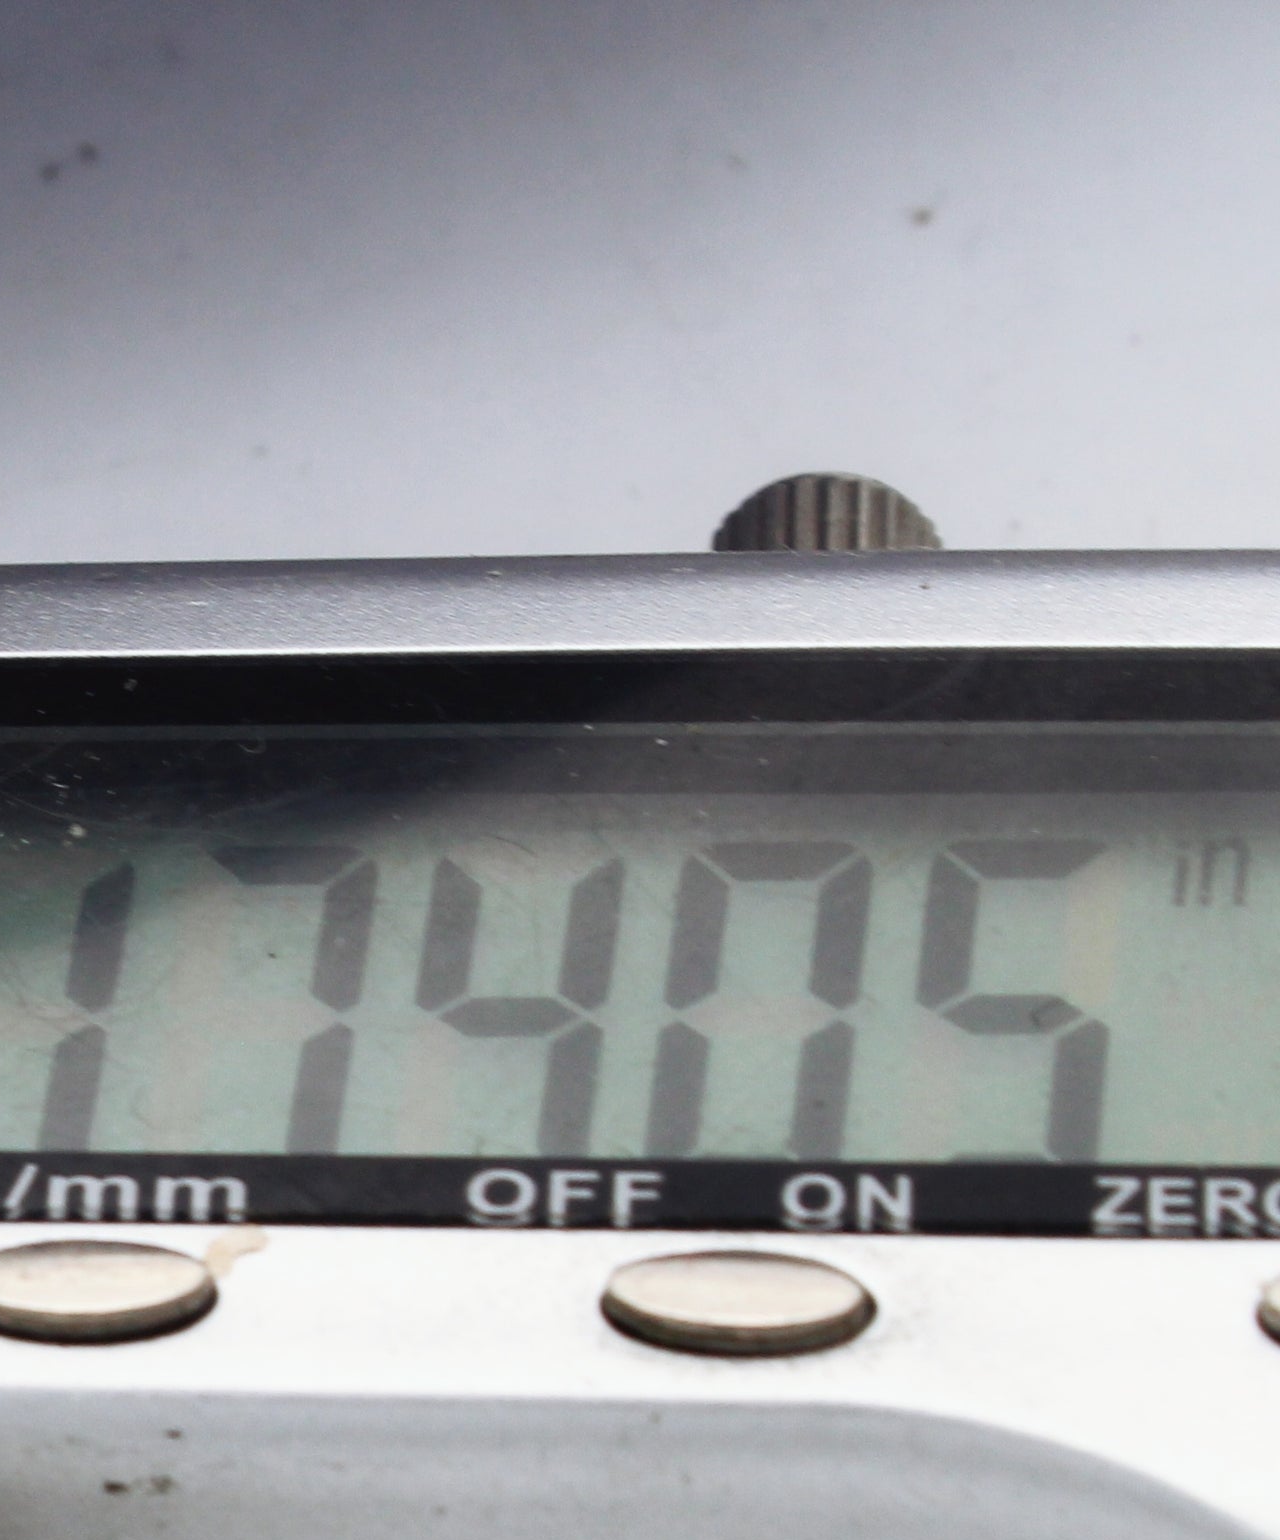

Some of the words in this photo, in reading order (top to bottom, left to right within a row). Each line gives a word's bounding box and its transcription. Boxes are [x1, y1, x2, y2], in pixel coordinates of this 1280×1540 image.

[466, 1167, 664, 1224] OFF
[781, 1172, 912, 1229] ON
[1091, 1175, 1280, 1230] ZER
